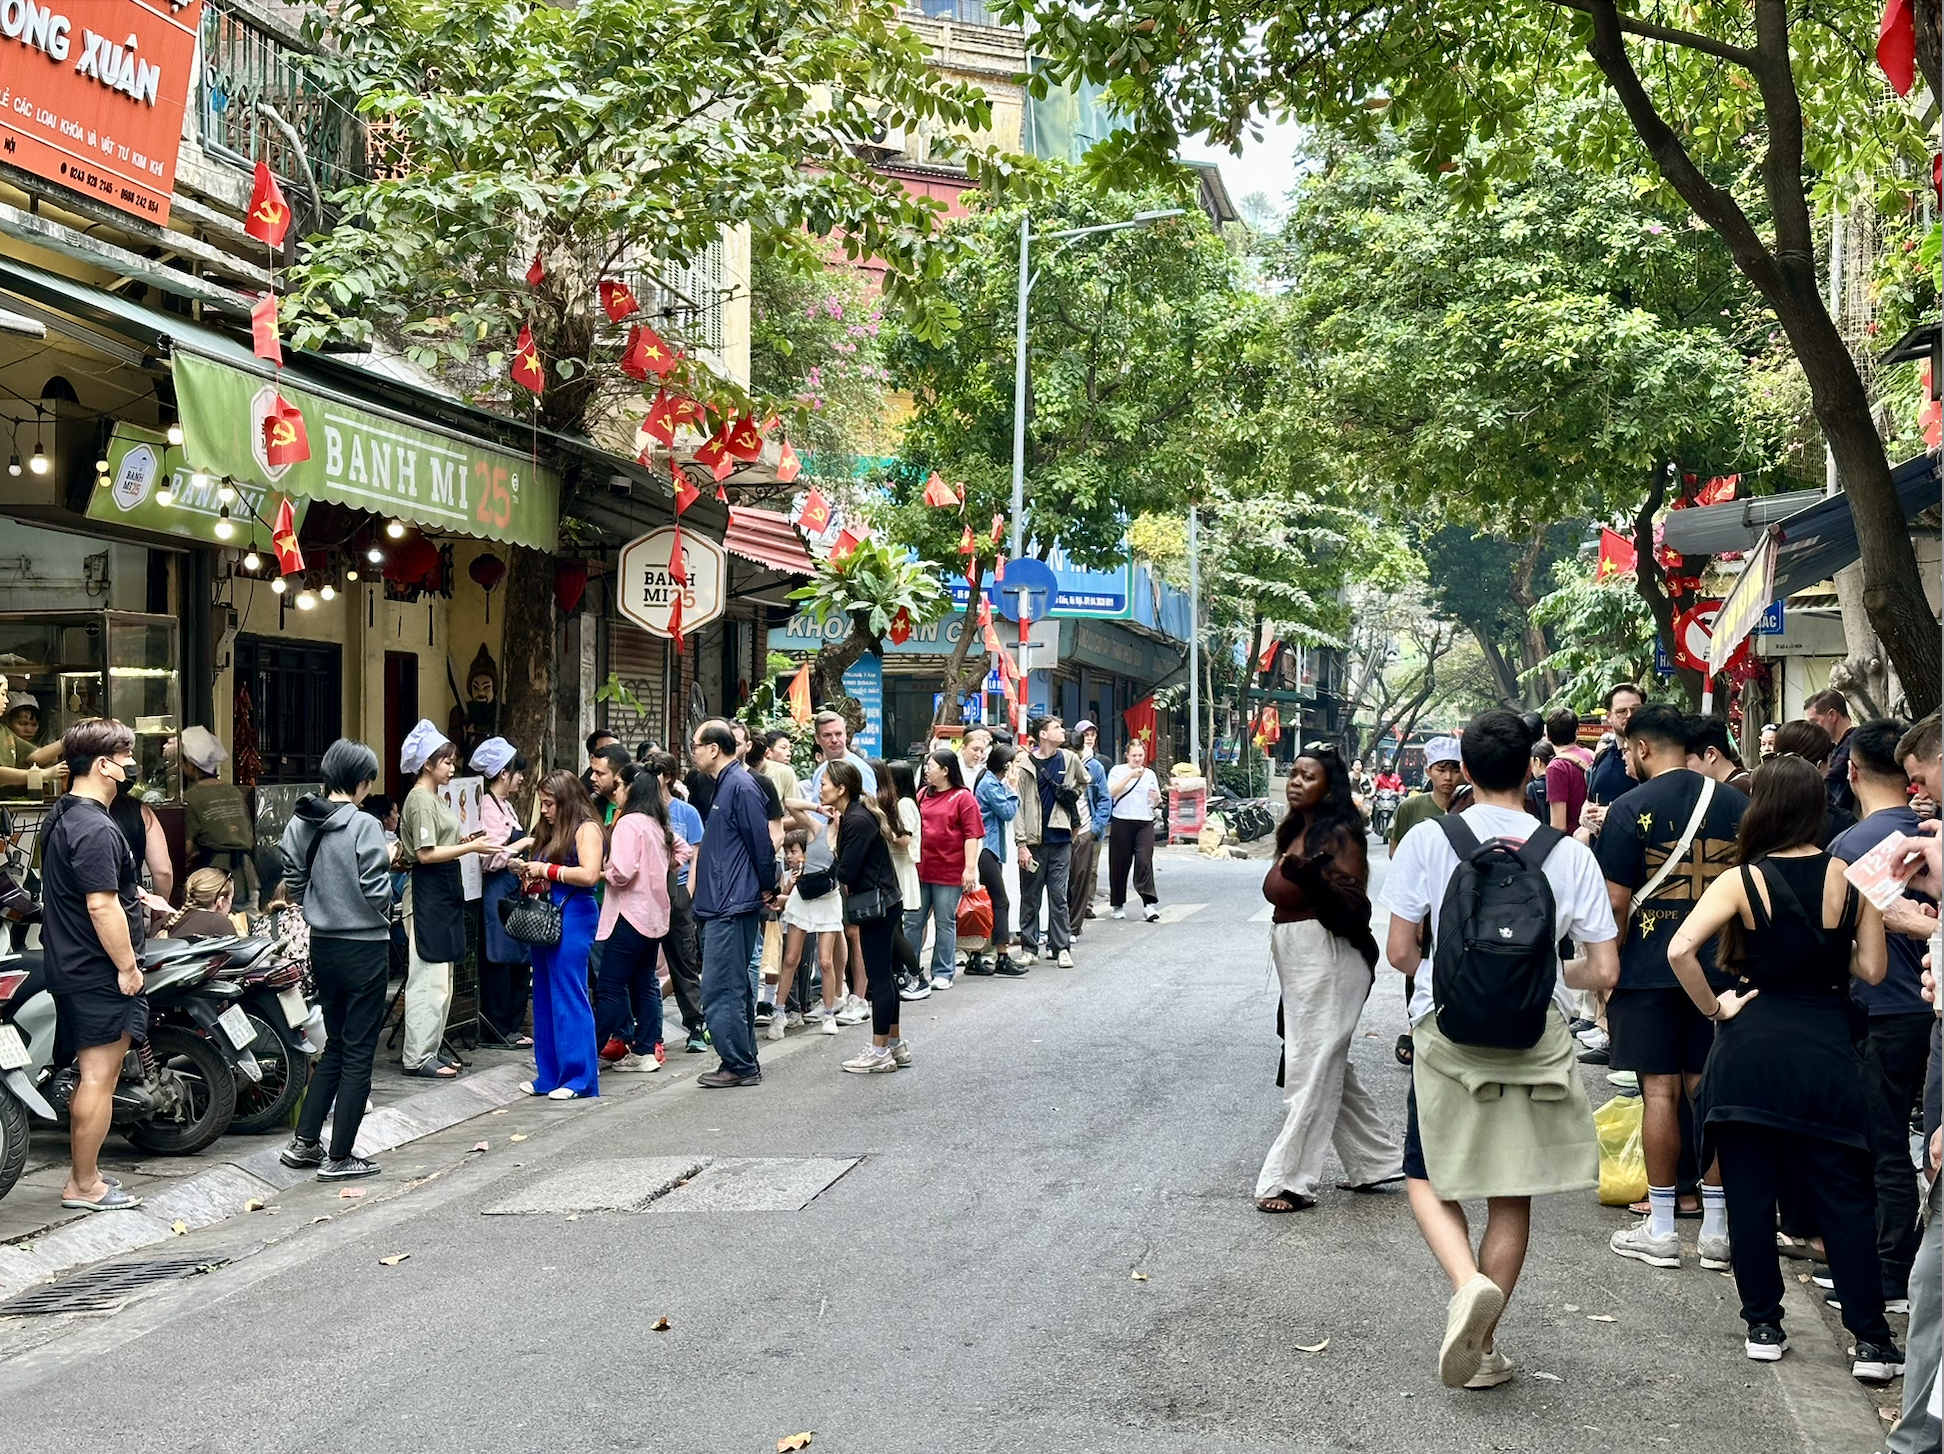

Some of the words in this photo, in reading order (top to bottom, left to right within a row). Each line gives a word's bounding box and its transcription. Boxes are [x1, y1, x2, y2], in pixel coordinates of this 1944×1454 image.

[75, 28, 161, 107] XUÂN
[13, 97, 33, 118] CÁC
[59, 119, 84, 142] KHÓA
[101, 136, 115, 156] VẬT
[118, 144, 130, 162] TƯ
[131, 151, 148, 170] KIM
[149, 160, 165, 178] KHÍ
[136, 194, 147, 209] 242
[233, 489, 265, 518] MI
[325, 425, 417, 497] BANH
[430, 457, 468, 510] MI
[475, 461, 511, 529] 25
